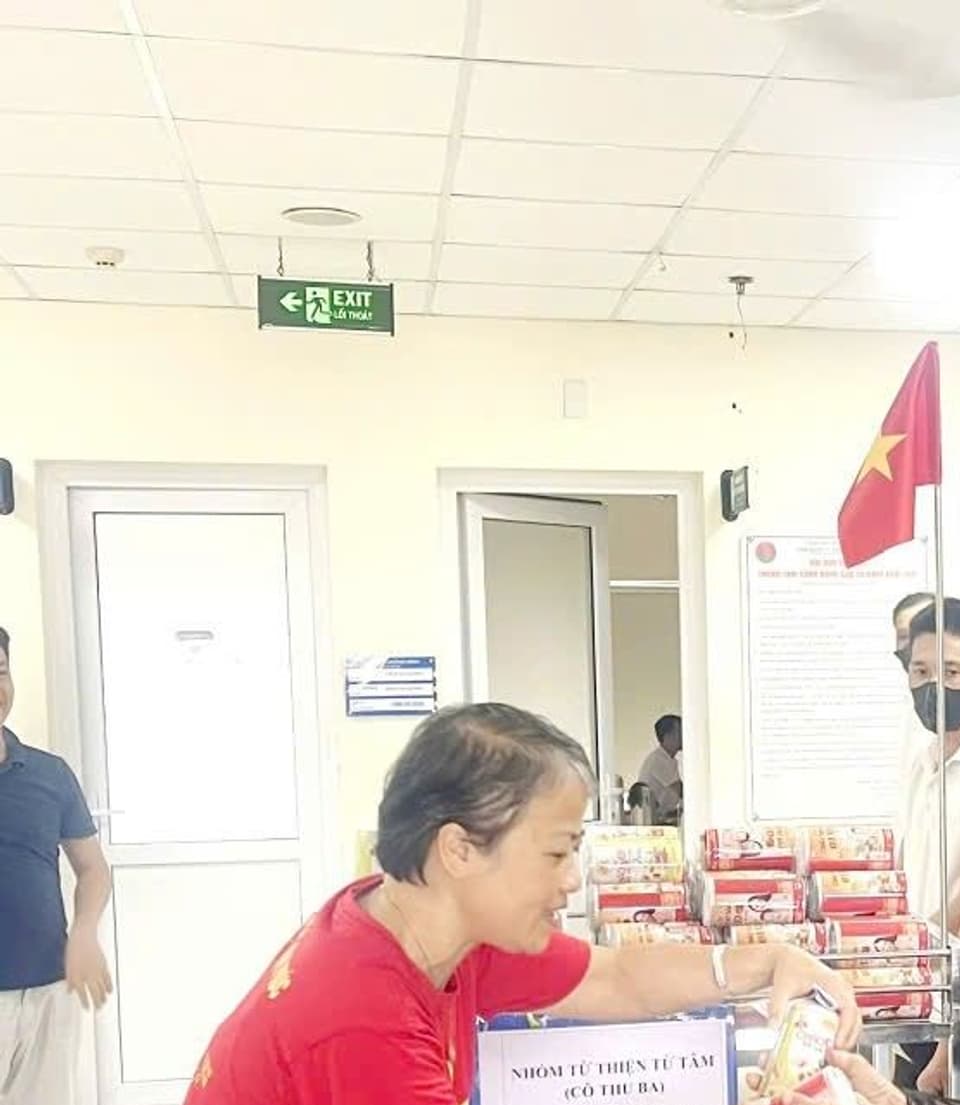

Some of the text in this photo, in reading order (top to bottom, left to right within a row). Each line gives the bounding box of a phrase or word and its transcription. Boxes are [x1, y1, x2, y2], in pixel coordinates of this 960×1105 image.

[333, 290, 373, 307] EXIT
[511, 1063, 563, 1080] NHÓM
[597, 1058, 648, 1077] THIỆN
[680, 1052, 714, 1070] TÂM
[564, 1081, 595, 1100] (CÔ
[638, 1080, 665, 1094] BA)
